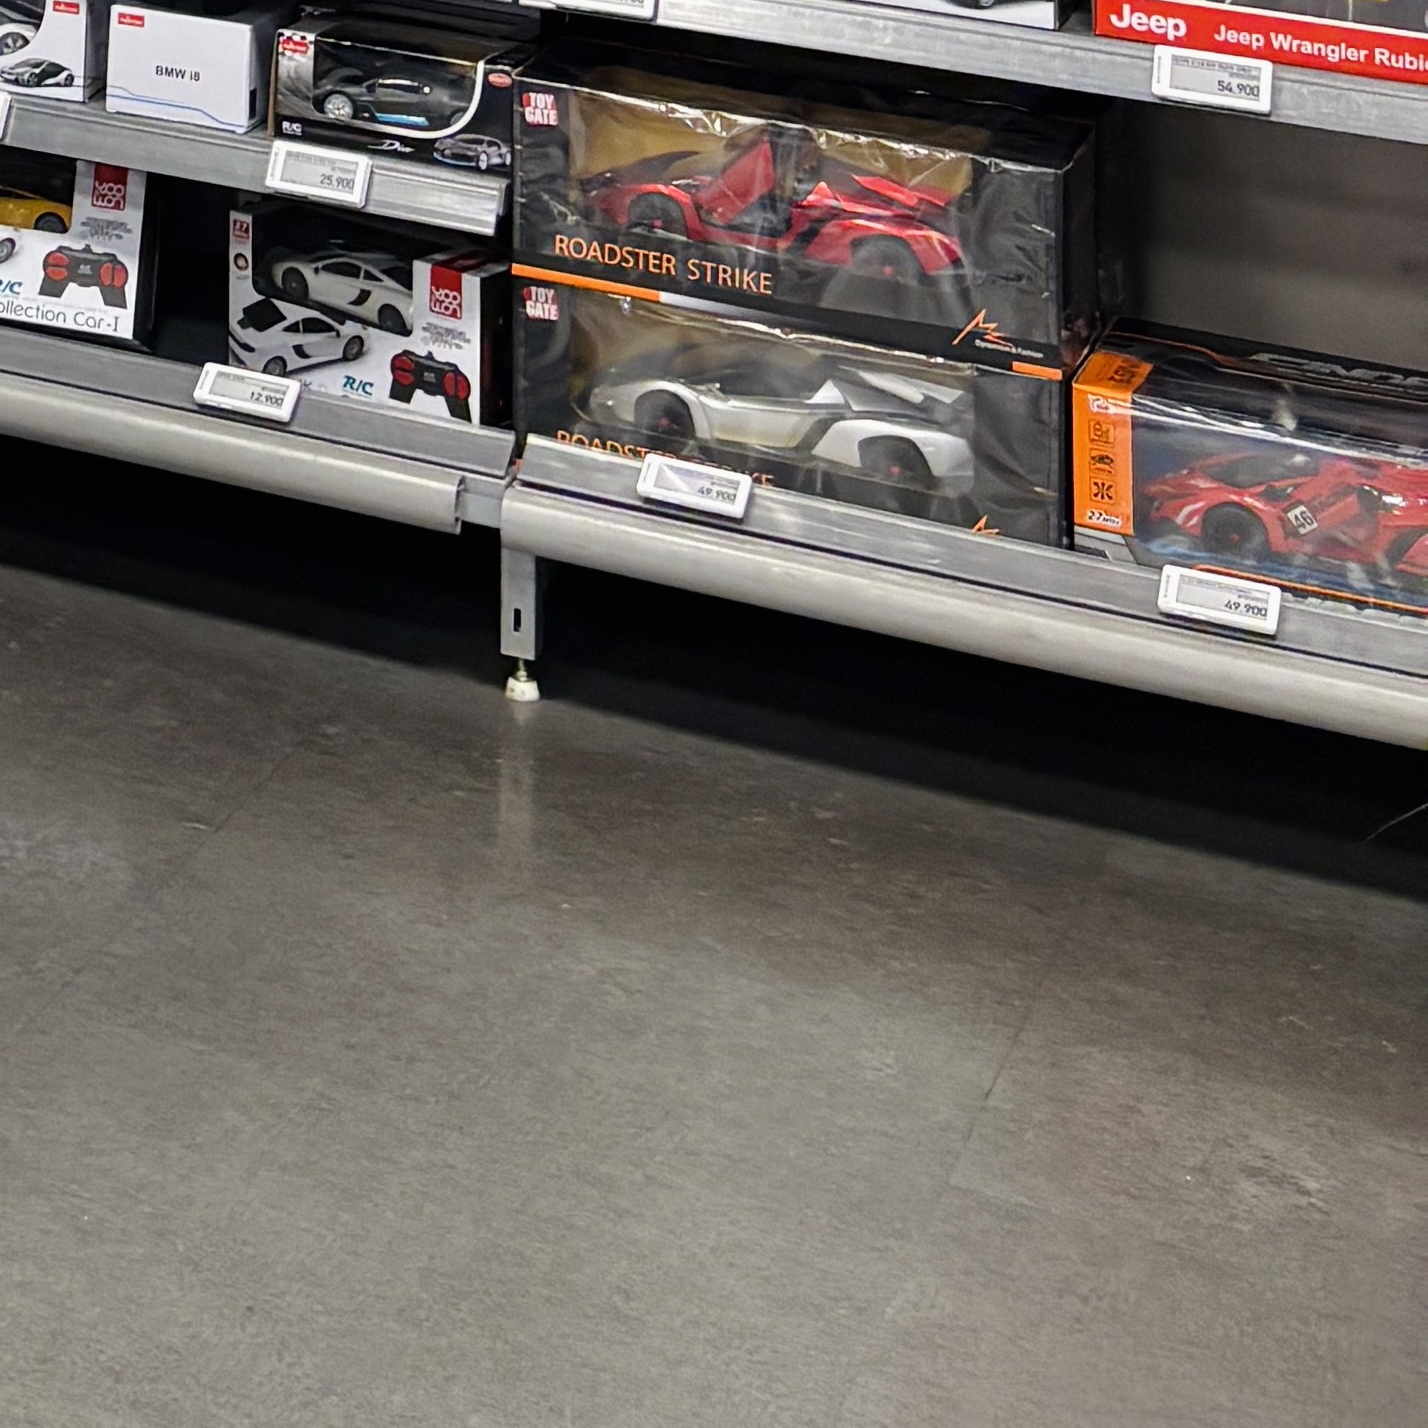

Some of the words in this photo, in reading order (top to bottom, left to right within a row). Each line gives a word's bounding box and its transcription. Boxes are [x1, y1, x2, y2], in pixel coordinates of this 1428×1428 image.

[1109, 4, 1187, 40] Jeep
[1214, 24, 1265, 49] Jeep
[1269, 31, 1371, 65] Wrangler
[155, 65, 186, 78] BMW
[1217, 80, 1260, 98] 54.900
[527, 92, 555, 109] TOY
[524, 106, 558, 127] GATE
[319, 174, 355, 190] 25.900
[554, 235, 677, 277] ROADSTER
[687, 259, 773, 295] STRIKE
[528, 286, 556, 305] TOY
[525, 302, 559, 322] GATE
[343, 375, 374, 396] R/C
[249, 391, 284, 408] 12.900
[1292, 510, 1313, 530] 46
[1223, 599, 1268, 619] 49.900
